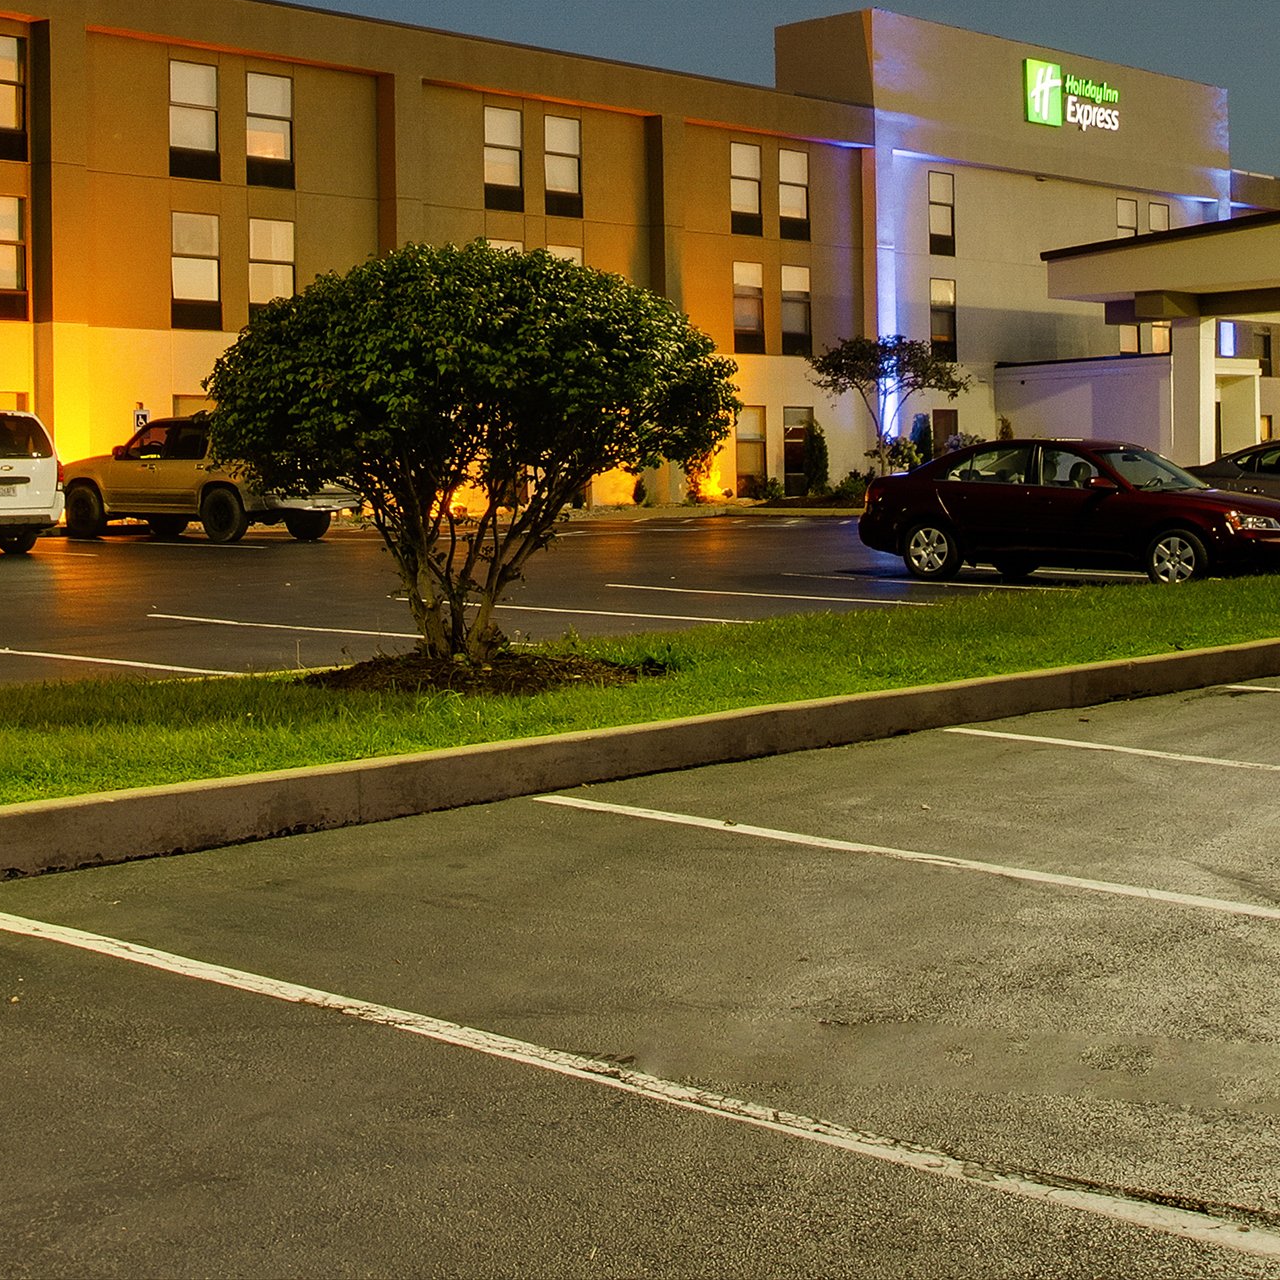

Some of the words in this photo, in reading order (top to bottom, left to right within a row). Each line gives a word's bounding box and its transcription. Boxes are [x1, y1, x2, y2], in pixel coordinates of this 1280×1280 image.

[1065, 74, 1102, 104] Holiday
[1102, 82, 1119, 103] Inn
[1066, 95, 1120, 131] Express
